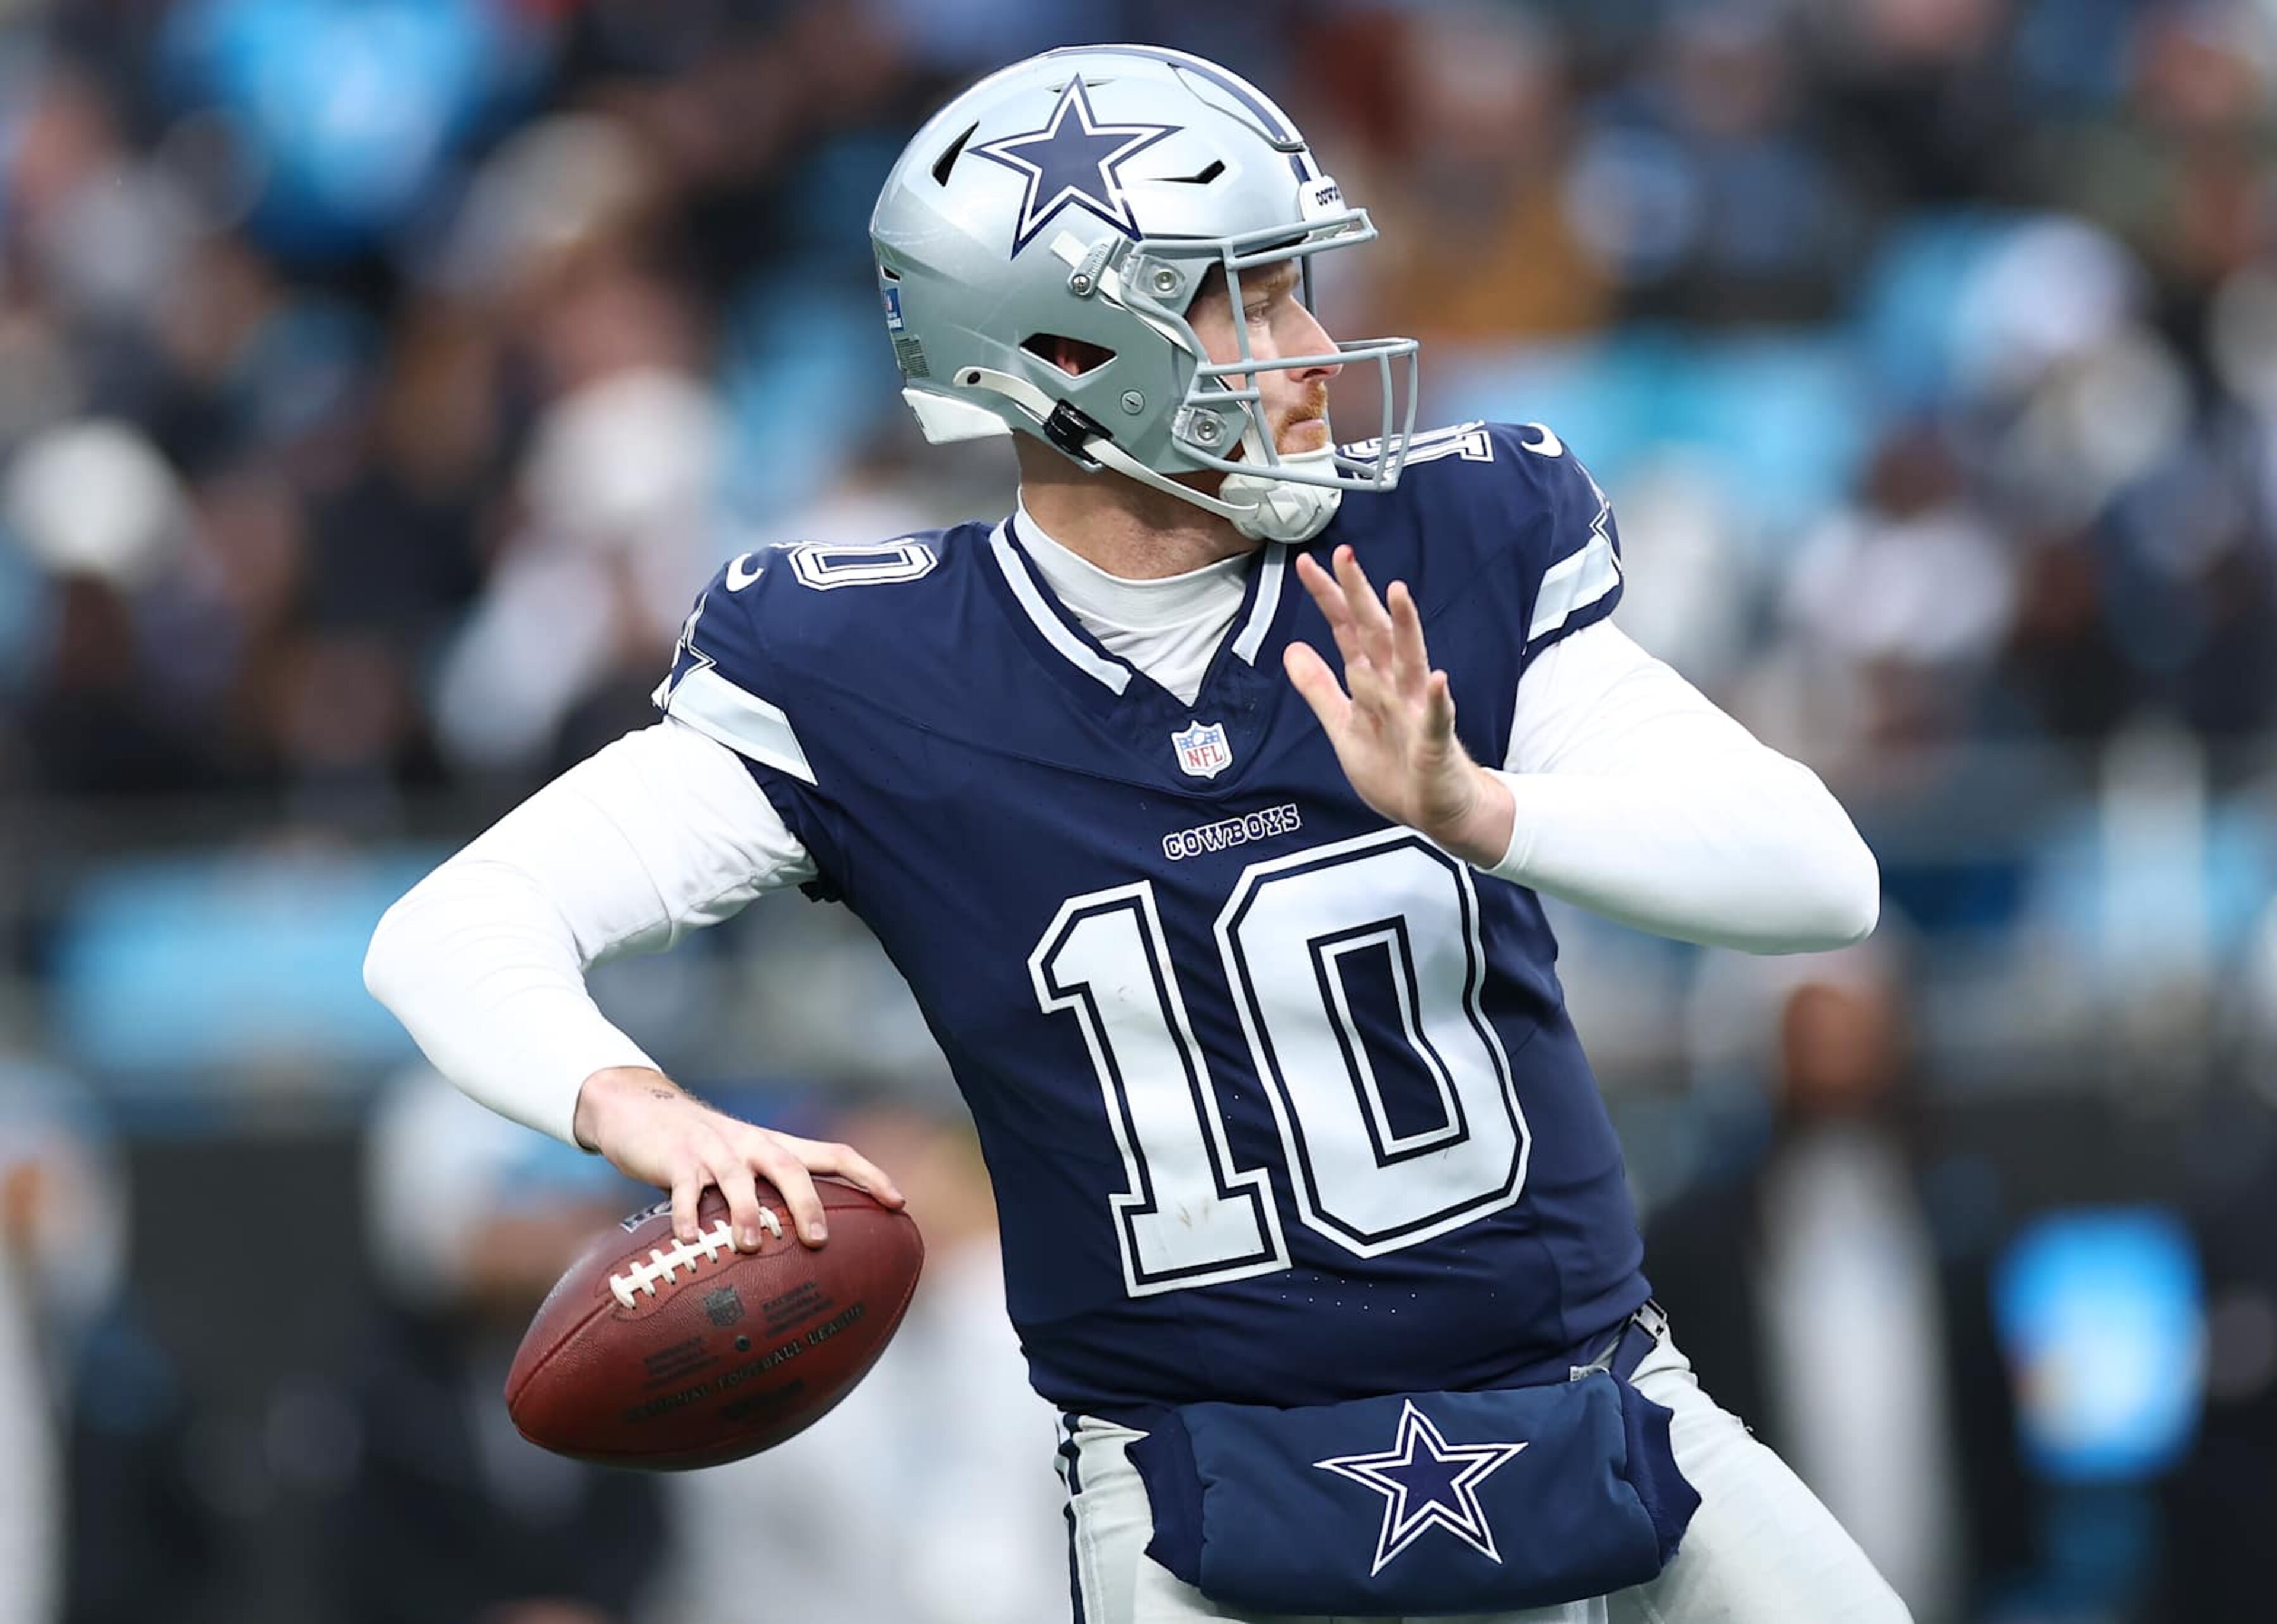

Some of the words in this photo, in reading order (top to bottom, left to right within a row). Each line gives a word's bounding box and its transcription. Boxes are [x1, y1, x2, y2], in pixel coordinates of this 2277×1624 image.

[1186, 745, 1223, 767] NFL
[1162, 803, 1300, 860] COWBOYS
[1027, 825, 1532, 1298] 10
